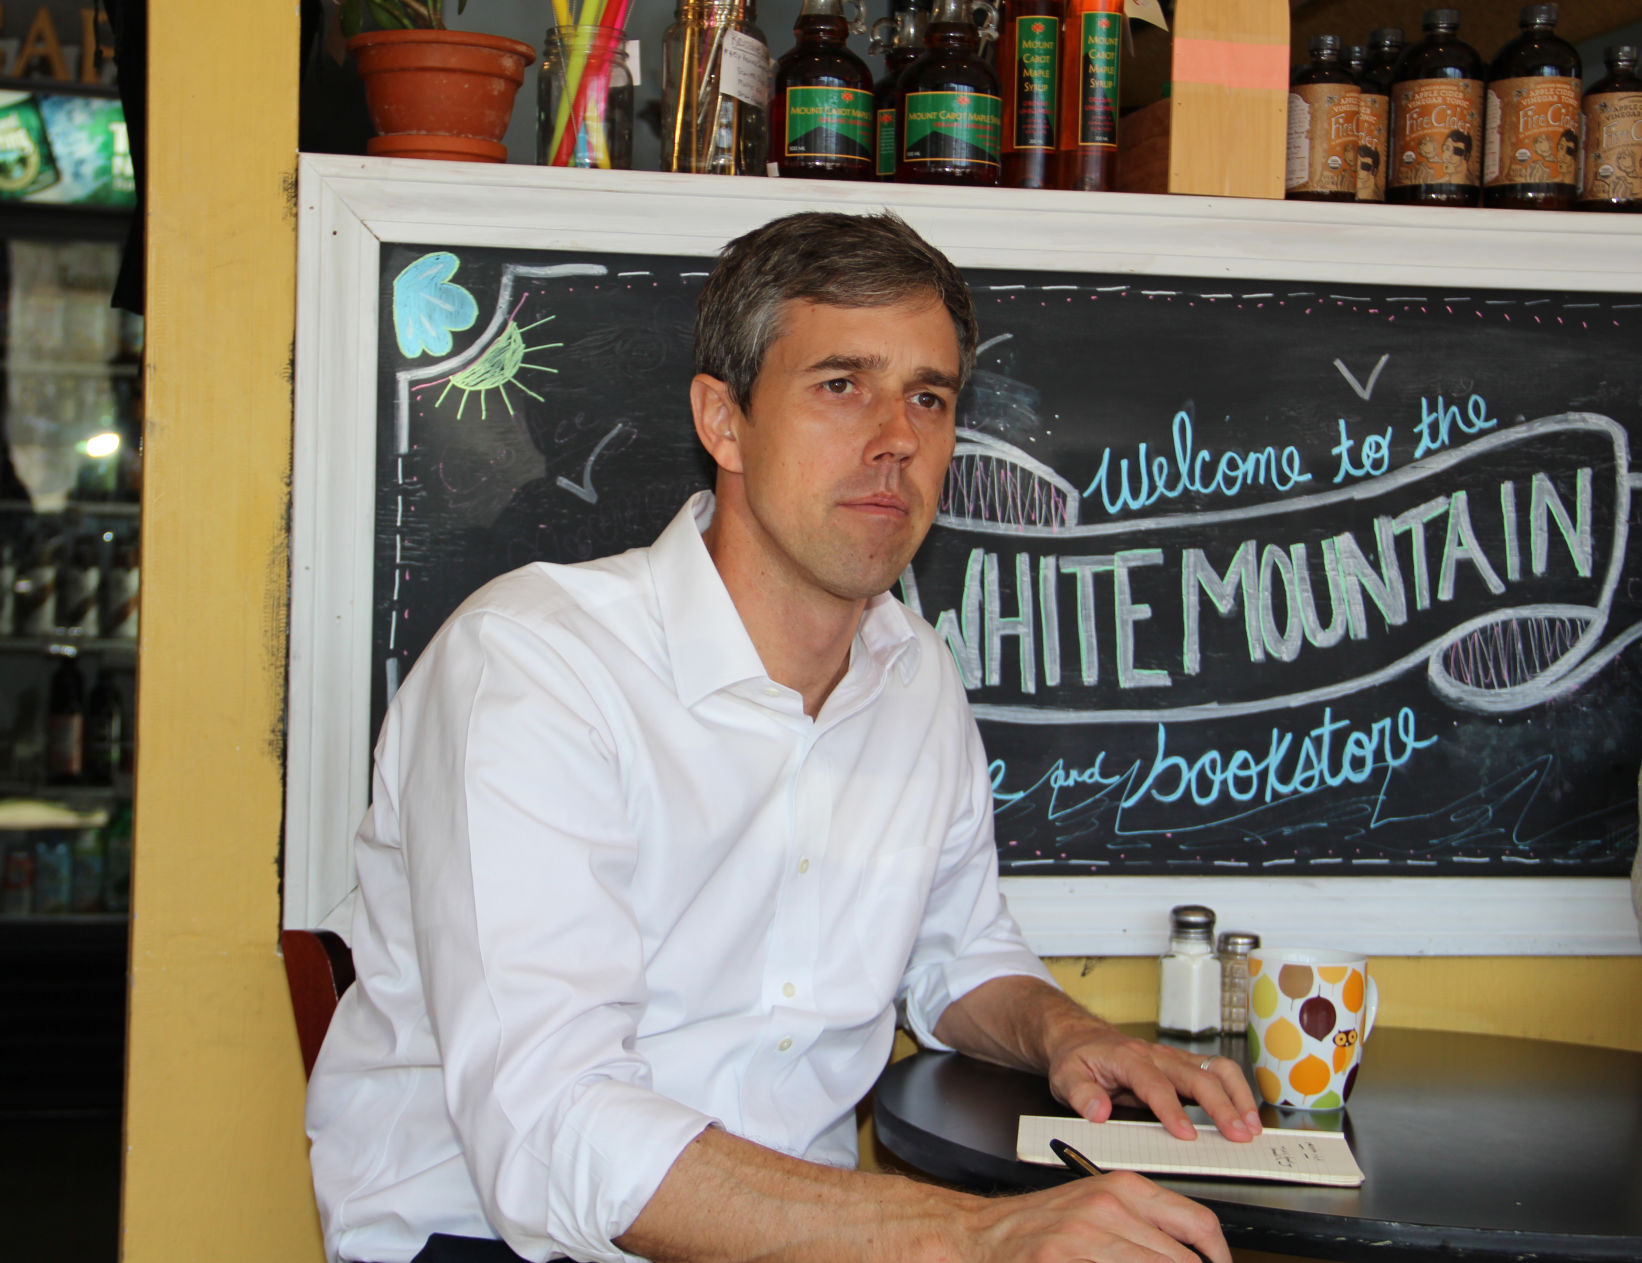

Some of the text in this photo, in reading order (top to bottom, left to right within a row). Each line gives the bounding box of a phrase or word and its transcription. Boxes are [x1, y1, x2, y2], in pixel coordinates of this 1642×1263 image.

[1022, 40, 1054, 49] MOUNT
[1088, 35, 1117, 45] MOUNT
[1023, 53, 1051, 63] CABOT
[1089, 48, 1115, 60] CABOT
[1023, 69, 1050, 78] MAPLE
[1089, 64, 1114, 74] MAPLE
[1024, 82, 1048, 92] SYRUP
[1090, 78, 1113, 88] SYRUP
[1415, 89, 1464, 99] APPLE CIDER
[1530, 88, 1554, 97] APPLE
[1408, 97, 1442, 108] VINEGAR
[791, 106, 823, 115] MOUNT
[824, 105, 850, 116] CABOT
[908, 111, 937, 120] MOUNT
[939, 110, 966, 121] CABOT
[1083, 394, 1497, 513] Welcome to the
[900, 468, 1592, 694] WHITE MOUNTAIN
[1050, 751, 1120, 788] and
[1120, 707, 1438, 808] bookstore
